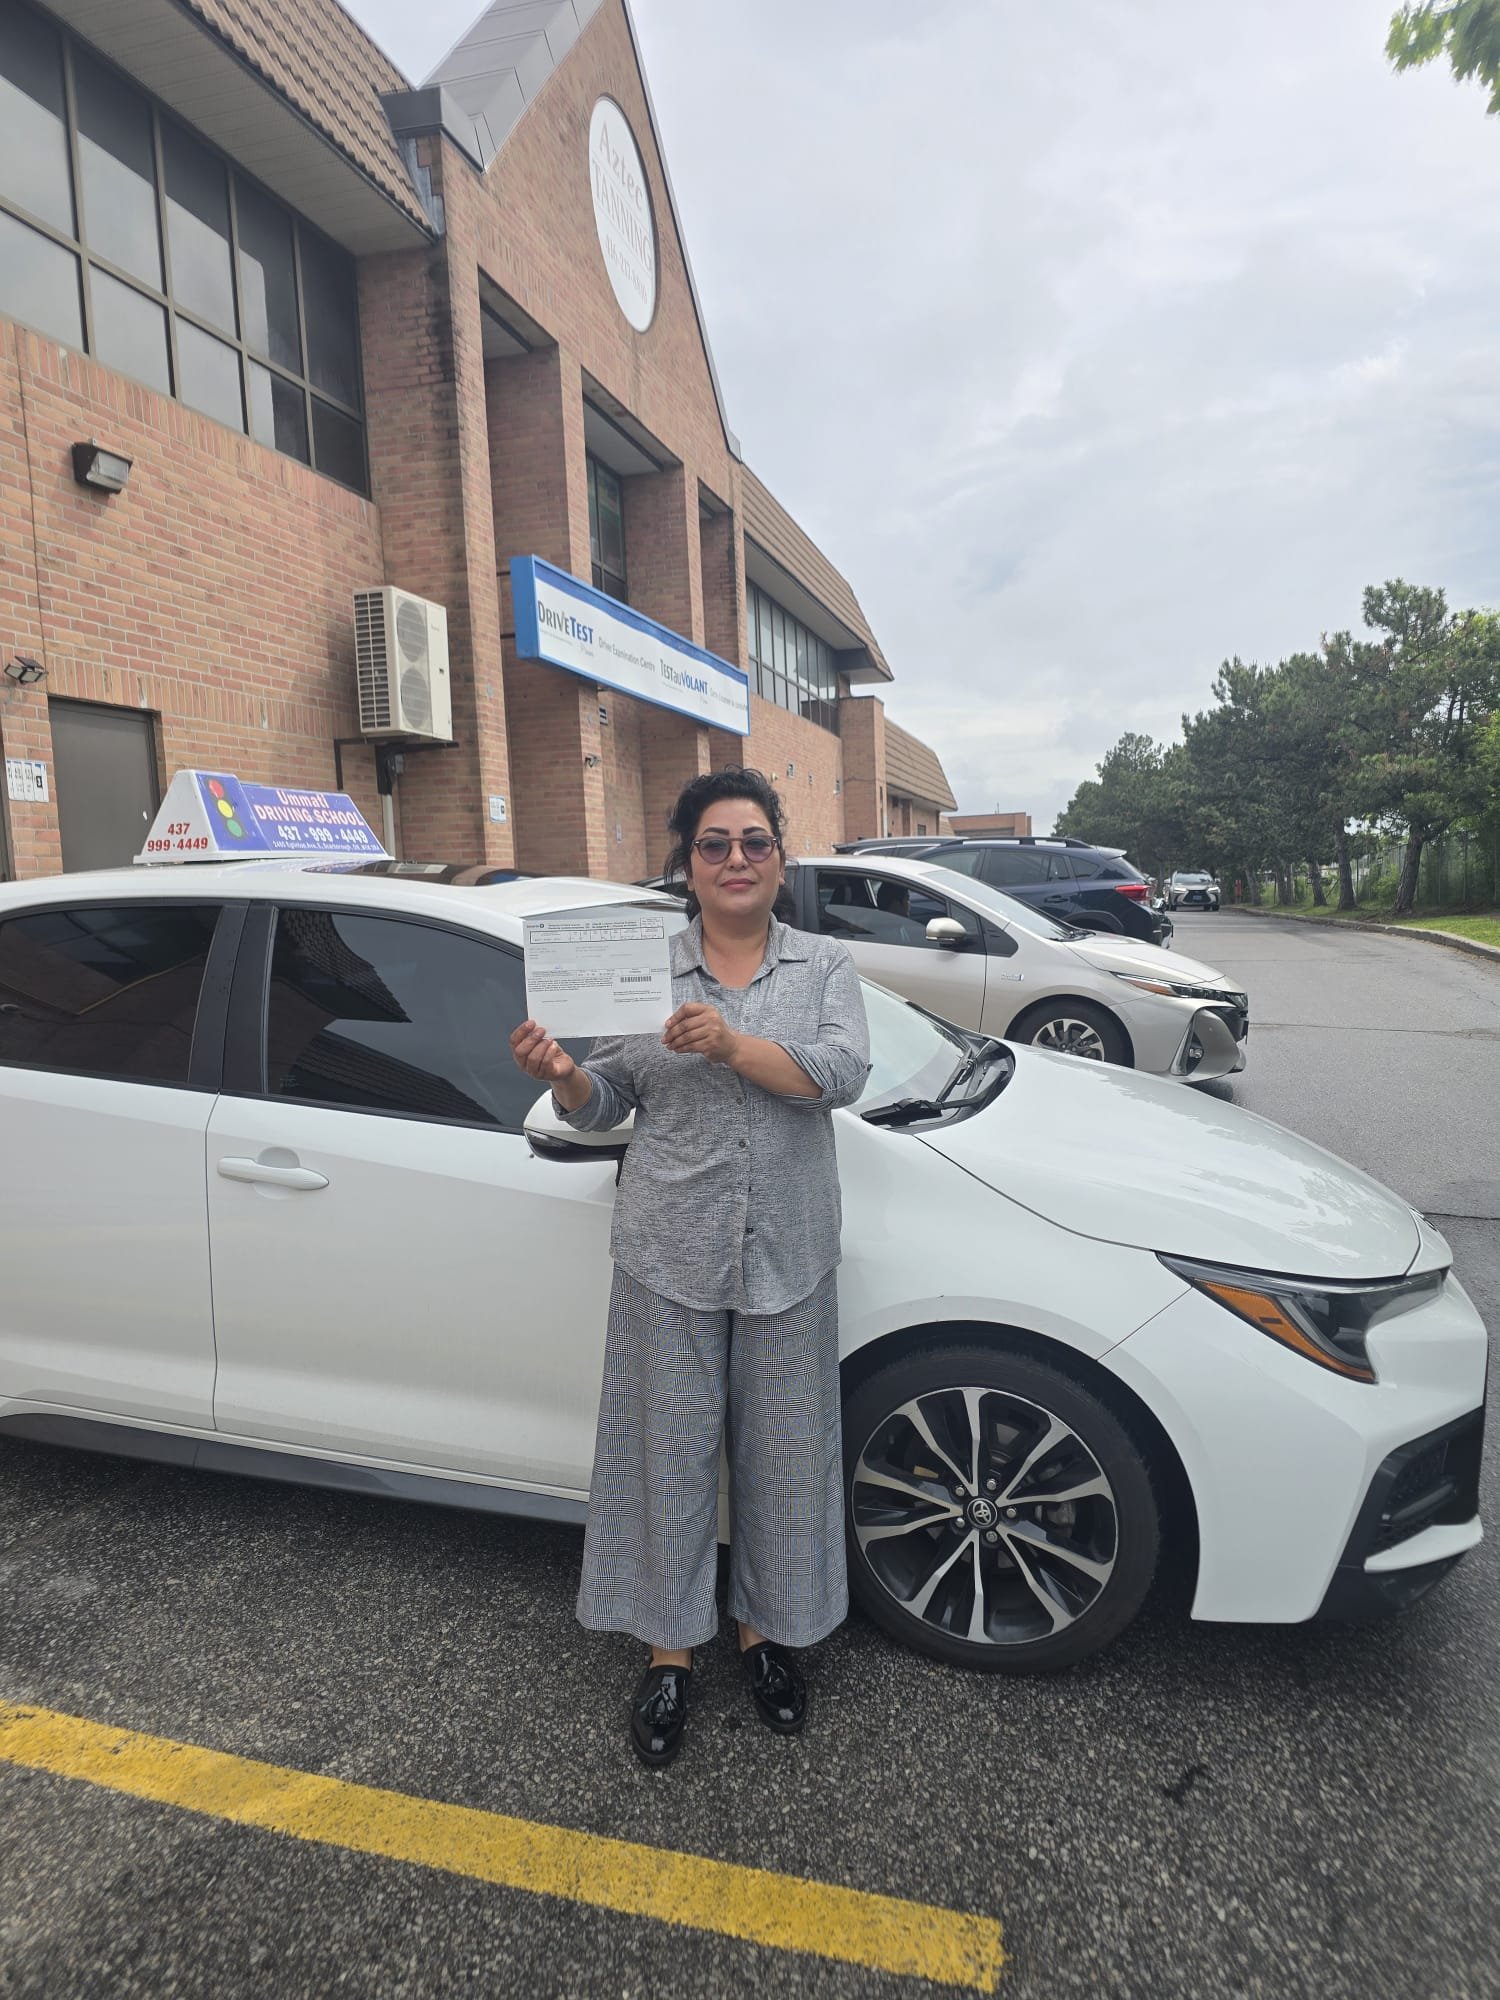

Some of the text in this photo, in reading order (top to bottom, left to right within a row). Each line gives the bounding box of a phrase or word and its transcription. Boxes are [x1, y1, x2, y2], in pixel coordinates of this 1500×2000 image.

[600, 120, 643, 210] Aztec
[592, 158, 652, 271] TANNING
[276, 790, 330, 808] Ummati
[255, 805, 364, 826] DRIVING SCHOOL
[167, 822, 191, 835] 437
[277, 825, 301, 841] 437
